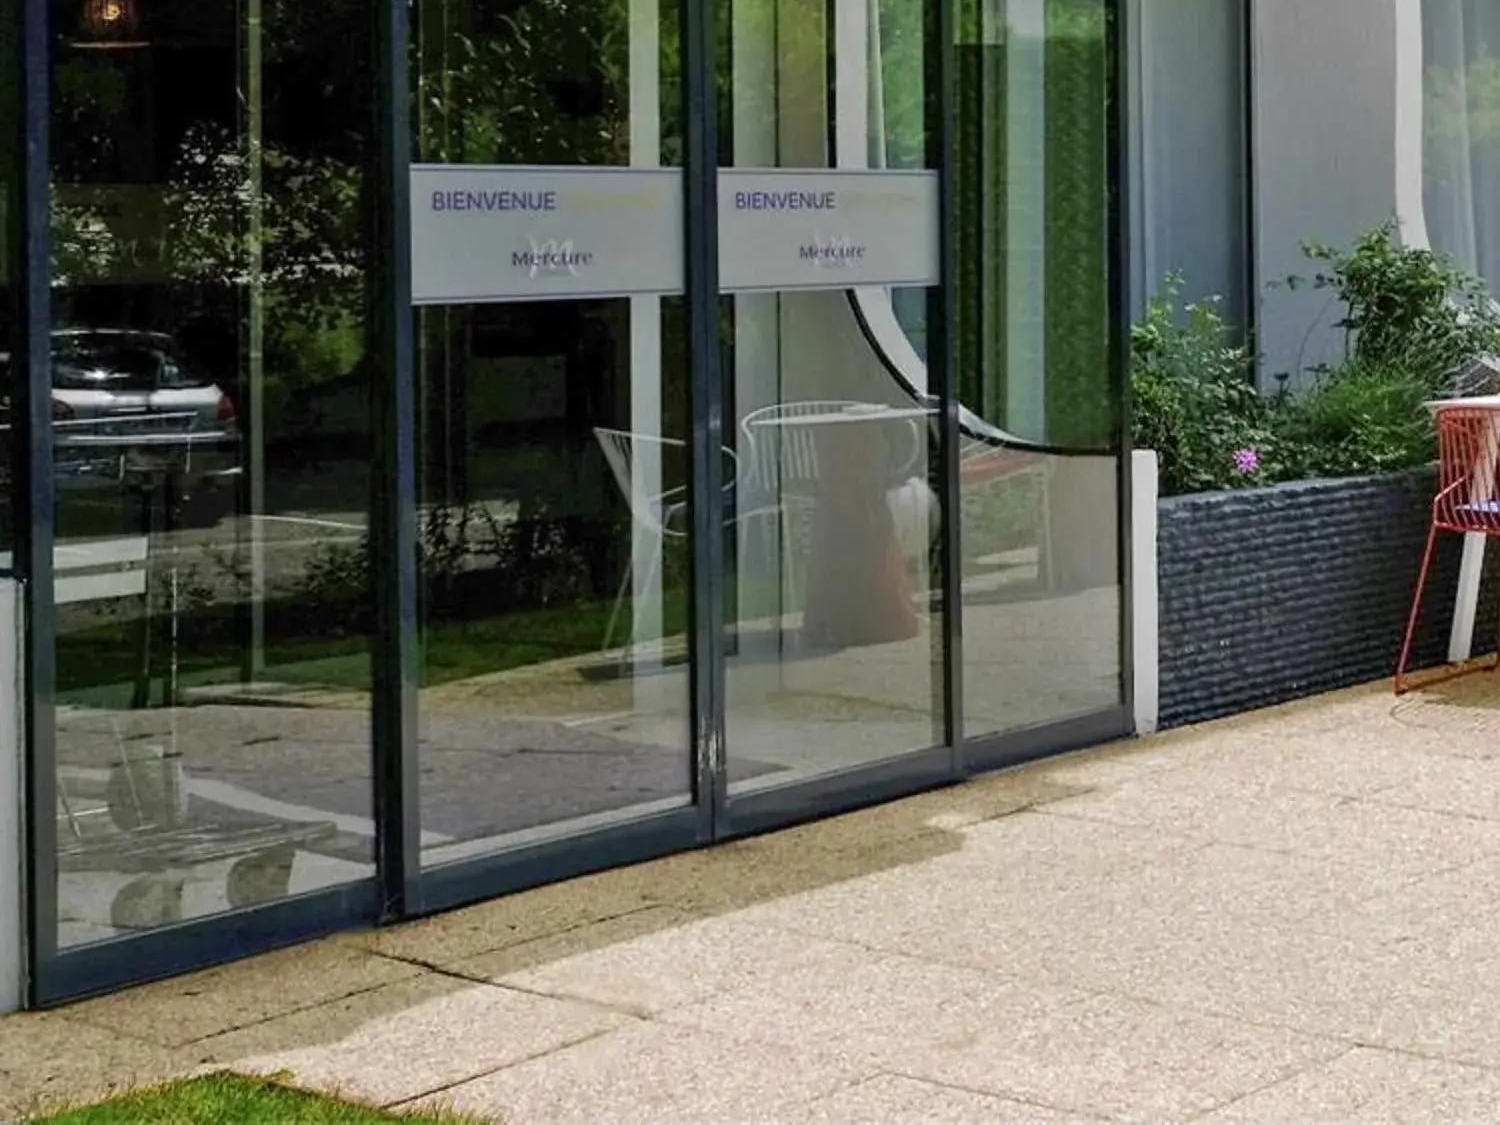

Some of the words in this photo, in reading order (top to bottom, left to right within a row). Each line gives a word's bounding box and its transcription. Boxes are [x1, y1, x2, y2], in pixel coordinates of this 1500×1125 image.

[431, 190, 557, 212] BIENVENUE
[734, 191, 836, 211] BIENVENUE
[511, 249, 594, 269] Mercure
